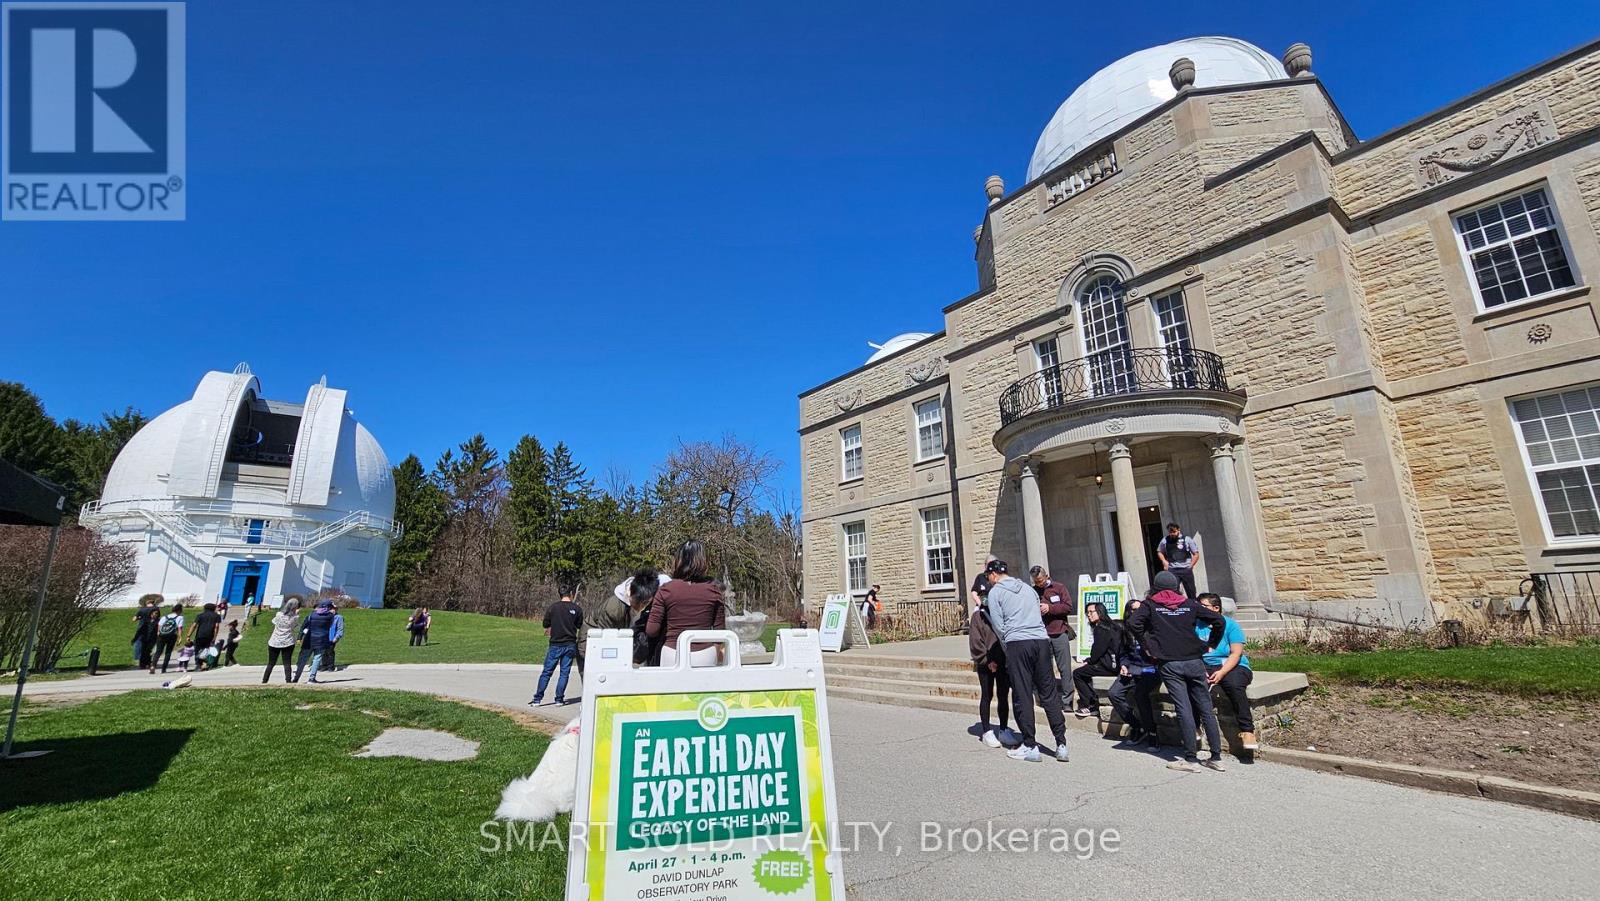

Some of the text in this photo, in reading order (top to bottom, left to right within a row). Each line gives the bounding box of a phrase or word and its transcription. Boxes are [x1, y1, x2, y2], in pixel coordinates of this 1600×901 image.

[635, 728, 651, 738] AN
[633, 731, 787, 778] EARTH DAY
[631, 771, 790, 819] EXPERIENCE
[630, 811, 790, 838] LEGACY OF THE LAND
[628, 859, 658, 873] April
[662, 857, 677, 868] 27
[690, 855, 697, 865] 1
[710, 853, 718, 863] 4
[721, 851, 746, 864] p.m.
[760, 860, 804, 878] FREE!
[652, 867, 724, 884] DAVID DUNLAP
[637, 878, 738, 899] OBSERVATORY PARK
